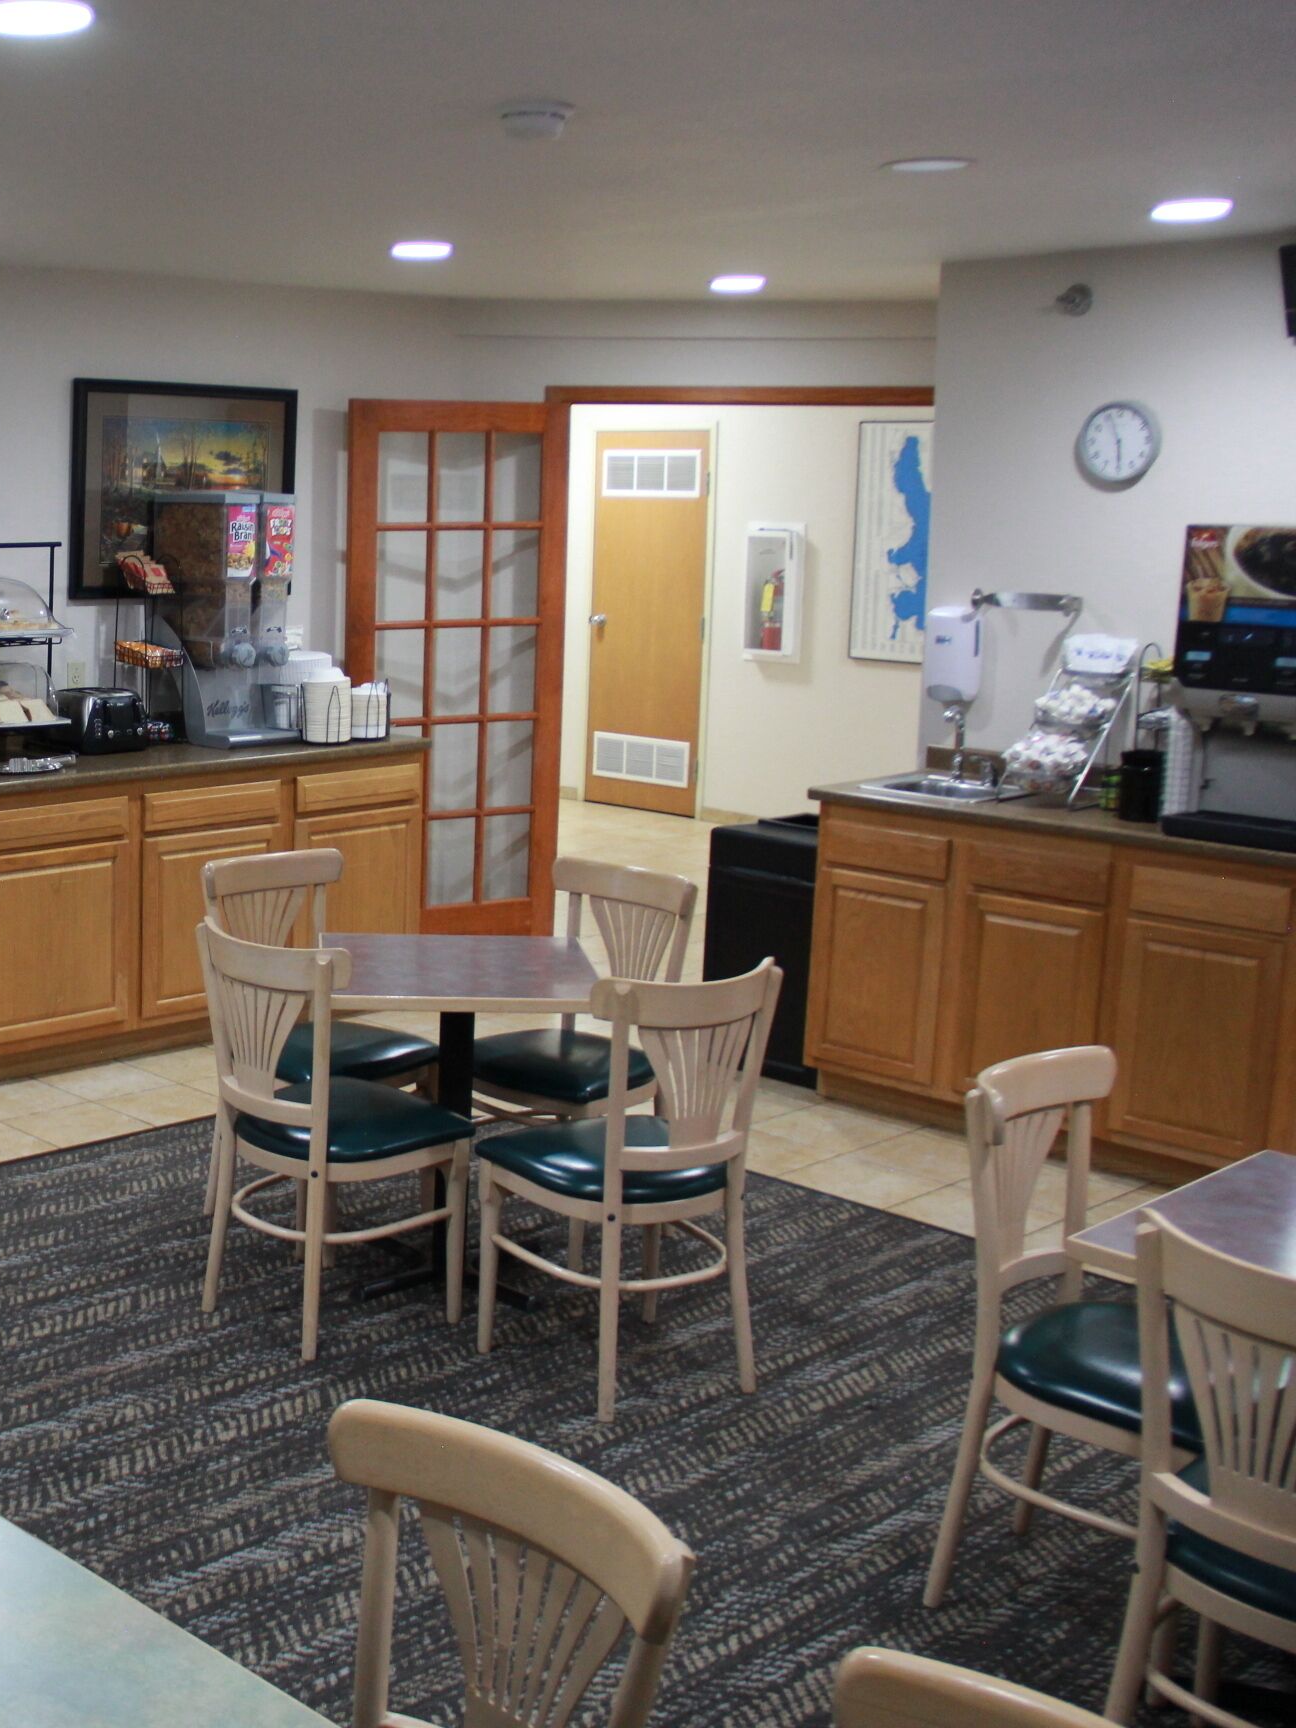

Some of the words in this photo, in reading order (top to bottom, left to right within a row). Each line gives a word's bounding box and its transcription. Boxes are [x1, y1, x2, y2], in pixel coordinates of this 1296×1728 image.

[231, 522, 255, 533] Raisin
[234, 531, 253, 541] Bran
[206, 699, 250, 718] Kellogg's
